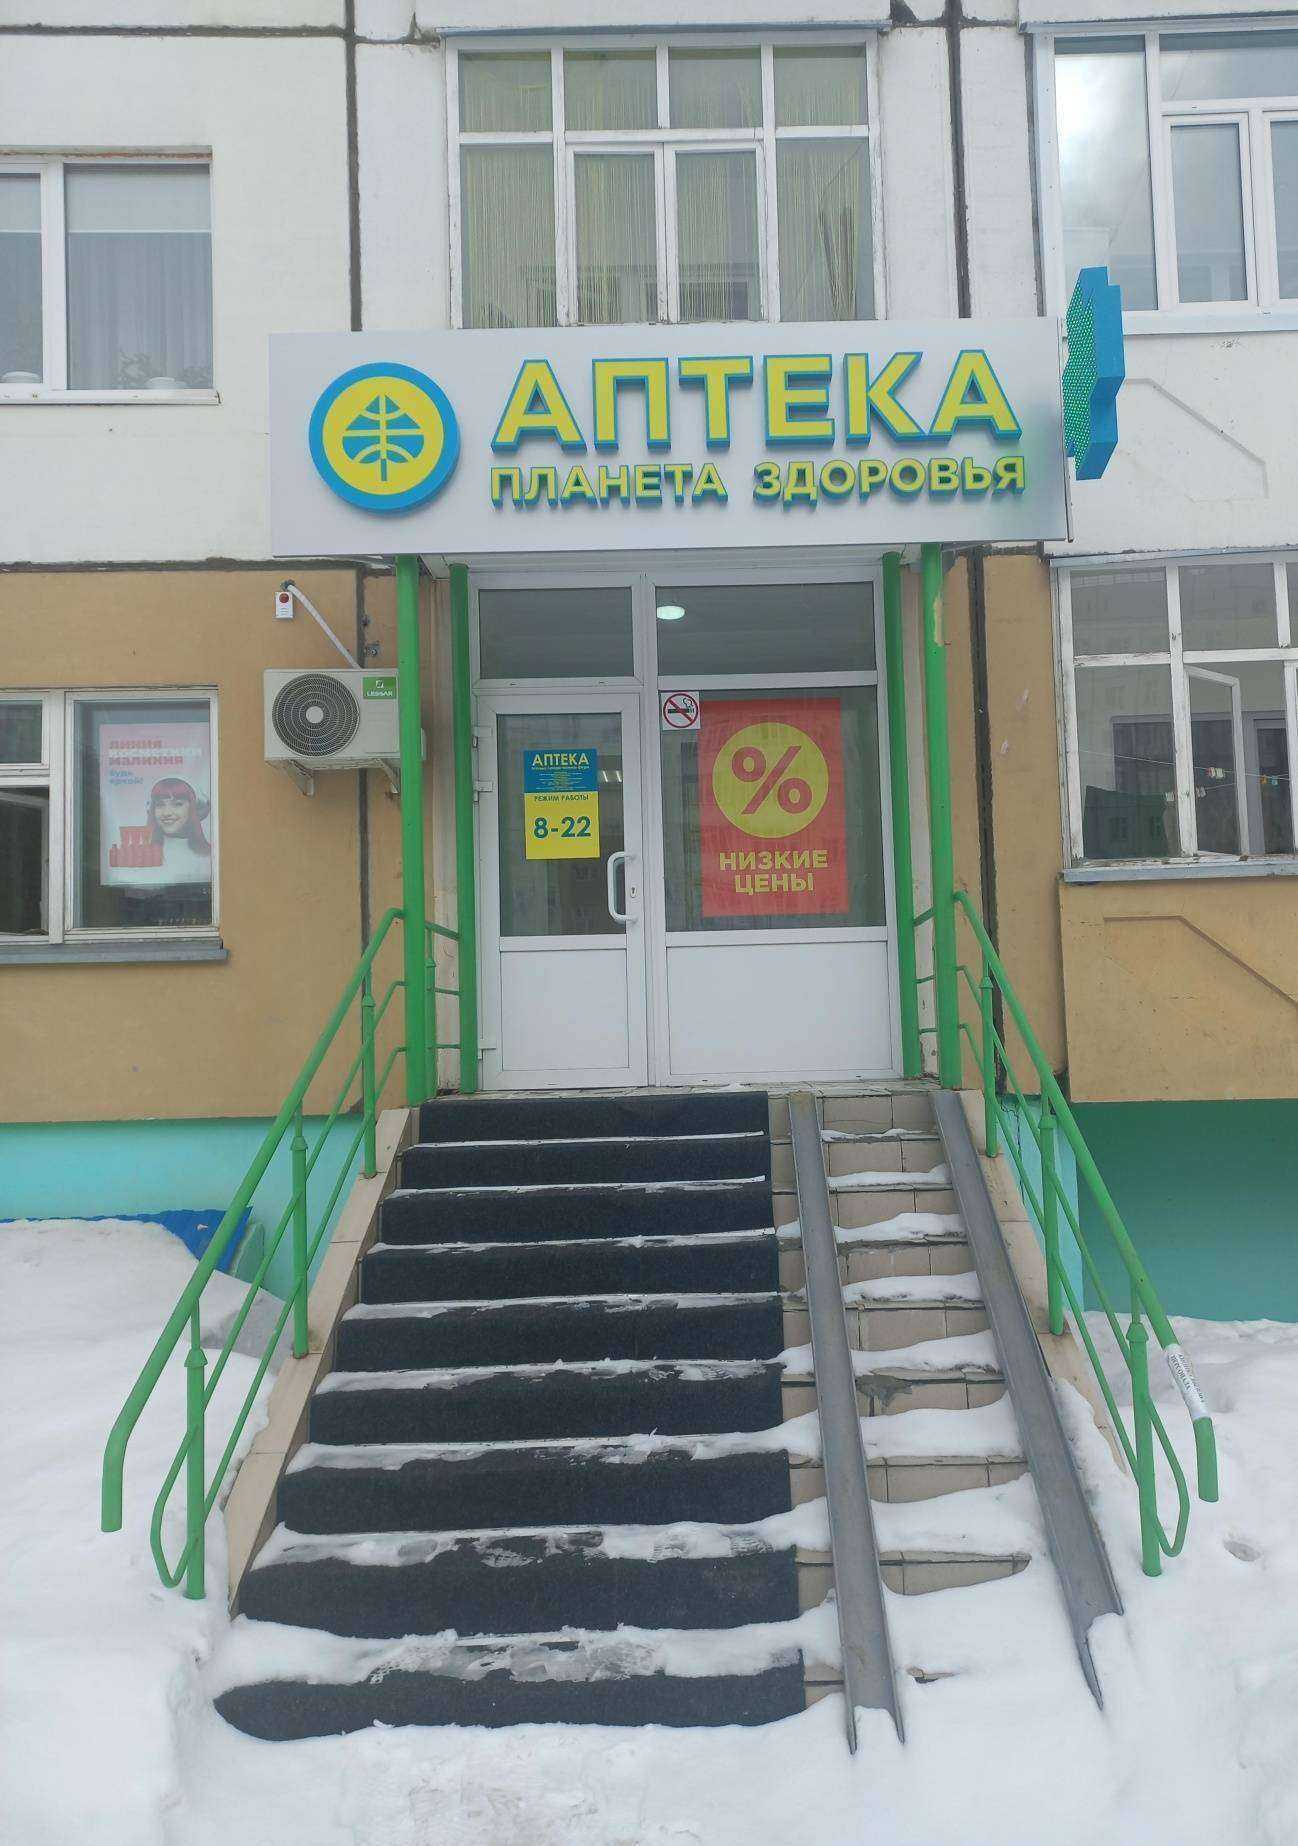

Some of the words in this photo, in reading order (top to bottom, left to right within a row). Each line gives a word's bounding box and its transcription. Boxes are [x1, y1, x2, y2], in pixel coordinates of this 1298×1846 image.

[490, 349, 1023, 452] АПТЕКА
[490, 461, 728, 507] ПЛАНЕТА
[752, 455, 1027, 511] ЗДОРОВЬЯ
[532, 752, 590, 767] АПТЕКА
[731, 745, 813, 814] %
[534, 795, 560, 803] РЕЖИМ
[561, 794, 589, 802] РАБОТЫ
[533, 815, 592, 839] 8-22
[719, 850, 829, 871] НИЗКИЕ
[734, 872, 814, 895] ЦЕНЫ
